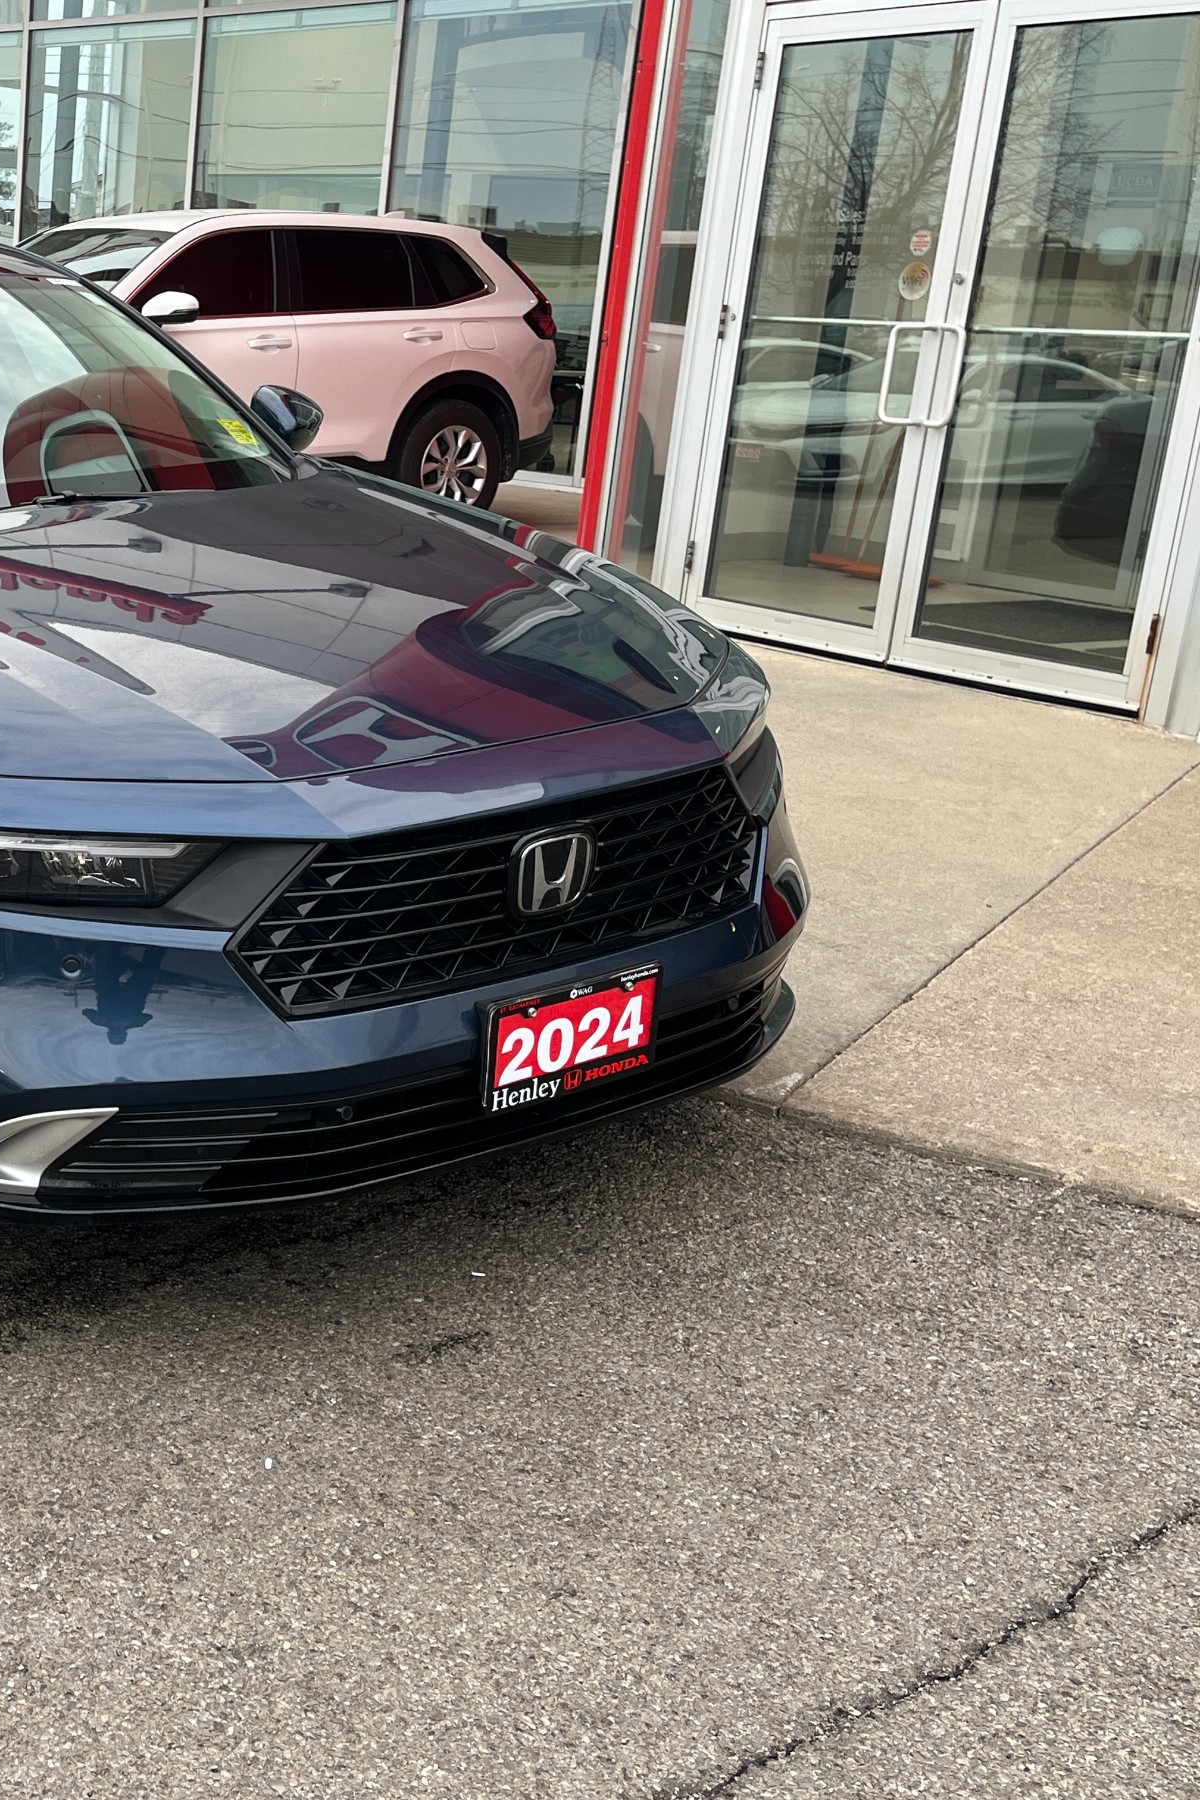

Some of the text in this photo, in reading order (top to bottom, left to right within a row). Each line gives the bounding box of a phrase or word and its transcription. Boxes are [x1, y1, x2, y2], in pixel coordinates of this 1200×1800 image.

[1117, 175, 1153, 187] UCDA
[577, 985, 594, 996] WAG
[497, 994, 644, 1087] 2024
[491, 1078, 561, 1112] Henley
[584, 1054, 649, 1082] HONDA
